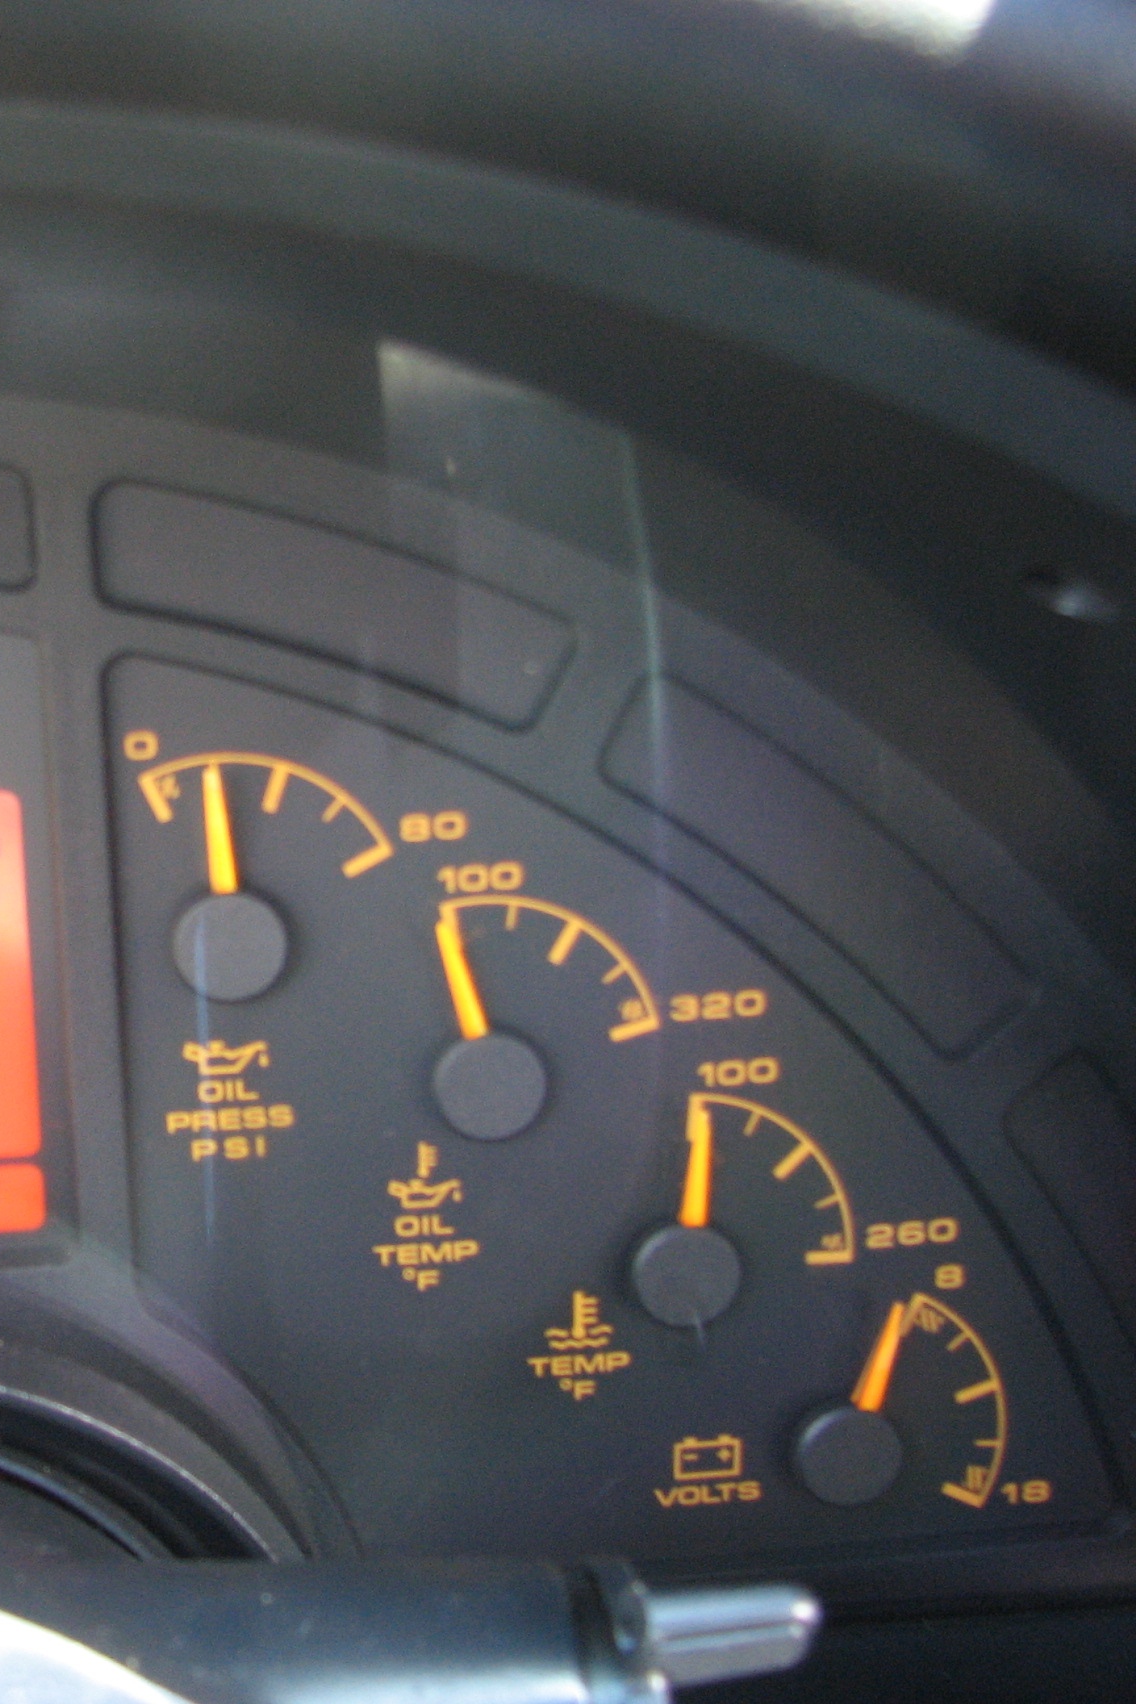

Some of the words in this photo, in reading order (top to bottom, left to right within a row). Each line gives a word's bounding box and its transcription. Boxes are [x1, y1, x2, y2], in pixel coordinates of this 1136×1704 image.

[123, 729, 159, 761] 0
[399, 810, 468, 843] 80
[437, 861, 524, 894] 100
[669, 988, 767, 1022] 320
[697, 1057, 780, 1087] 100
[197, 1078, 259, 1103] OIL
[166, 1104, 295, 1134] PRESS
[393, 1214, 455, 1237] OIL
[865, 1217, 960, 1249] 260
[372, 1239, 480, 1267] TEMP
[934, 1264, 965, 1290] 8
[527, 1351, 631, 1378] TEMP
[655, 1481, 761, 1506] VOLTS
[1002, 1479, 1051, 1504] 18
